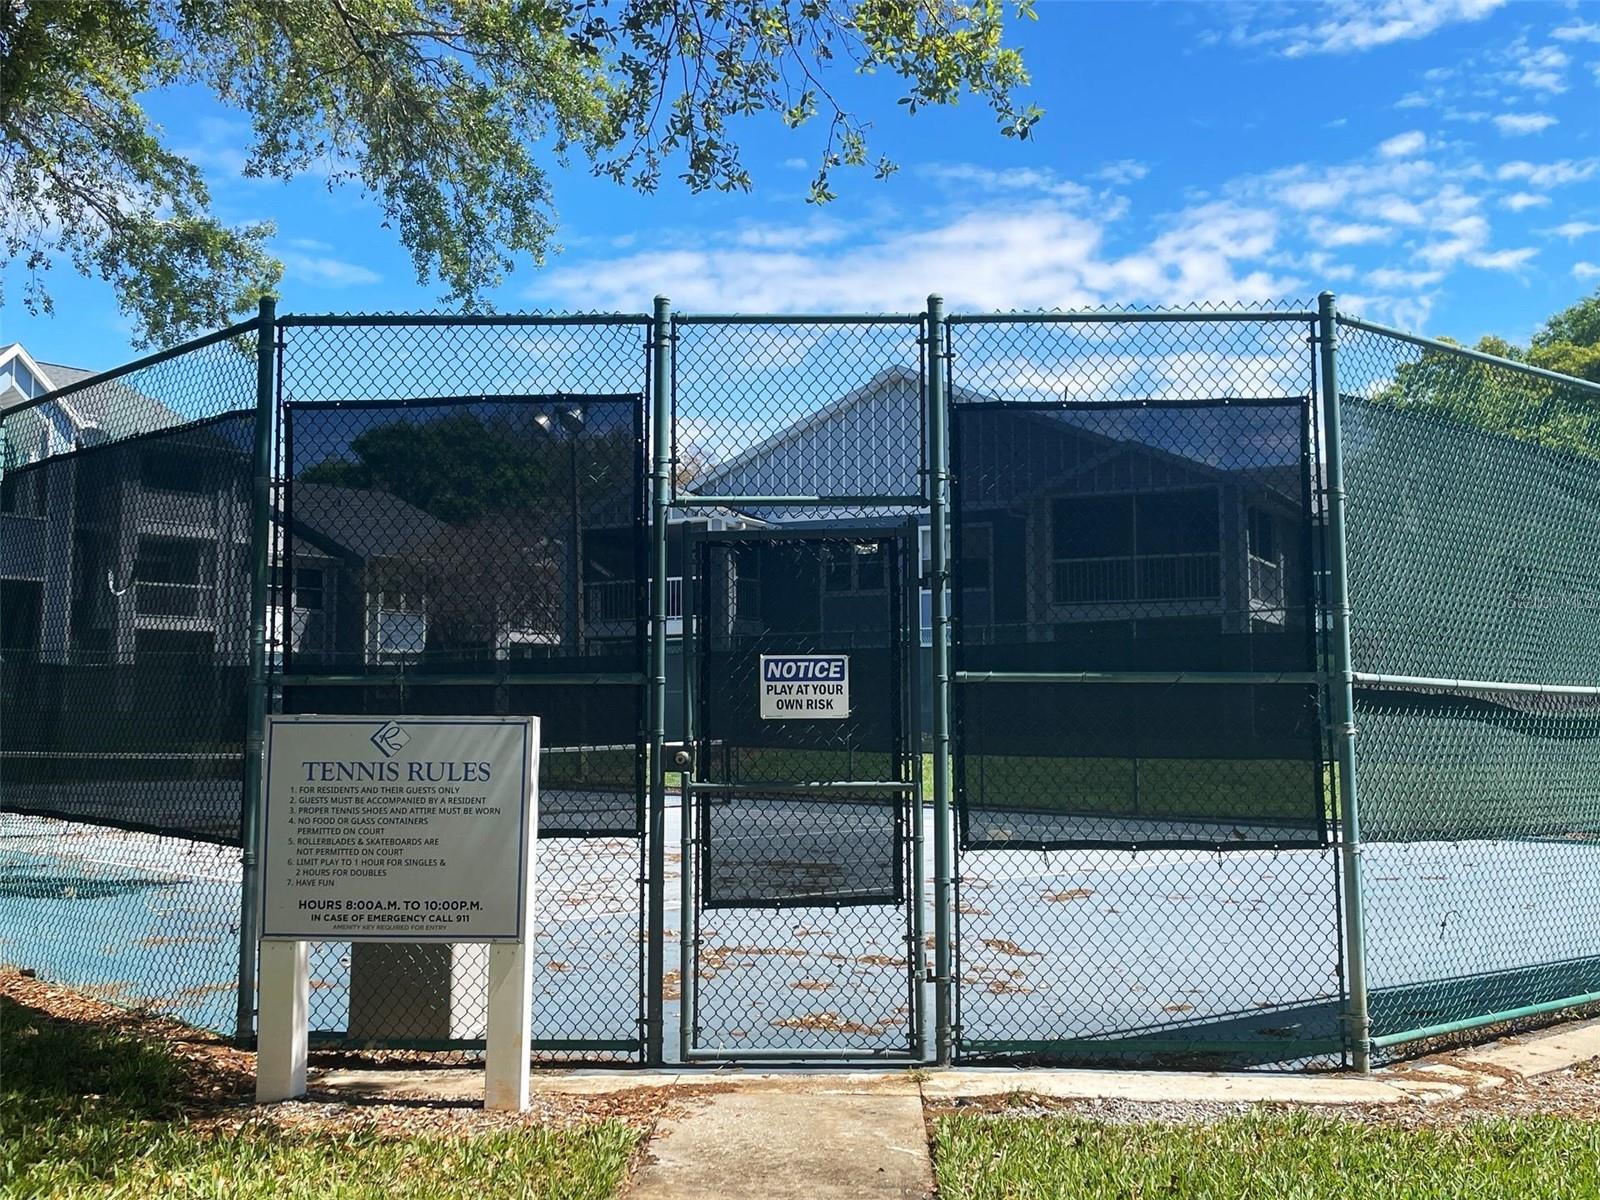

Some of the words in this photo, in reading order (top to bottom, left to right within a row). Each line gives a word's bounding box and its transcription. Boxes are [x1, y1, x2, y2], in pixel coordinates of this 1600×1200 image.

[767, 661, 843, 679] NOTICE
[766, 683, 794, 696] PLAY
[795, 683, 810, 696] AT
[811, 683, 844, 696] YOUR
[776, 698, 803, 711] OWN
[806, 698, 834, 711] RISK
[302, 762, 399, 782] TENNIS
[408, 762, 490, 782] RULES
[289, 786, 298, 795] 1.
[298, 786, 316, 795] FOR
[316, 786, 360, 795] RESIDENTS
[361, 786, 379, 795] AND
[380, 786, 405, 795] THEIR
[405, 786, 437, 795] GUESTS
[437, 786, 461, 795] ONLY
[289, 796, 297, 805] 2.
[298, 796, 329, 805] GUESTS
[330, 796, 354, 805] MUST
[354, 796, 365, 805] BE
[365, 796, 427, 805] ACCOMPANIED
[428, 796, 439, 805] BY
[439, 796, 447, 805] A
[447, 796, 487, 805] RESIDENT
[289, 806, 297, 815] 3.
[298, 806, 330, 815] PROPER
[330, 806, 361, 815] TENNIS
[361, 806, 389, 815] SHOES
[389, 806, 408, 815] AND
[408, 806, 437, 815] ATTIRE
[438, 806, 462, 815] MUST
[463, 806, 473, 815] BE
[474, 806, 501, 815] WORN
[287, 816, 297, 825] 4.
[297, 816, 311, 825] NO
[312, 816, 336, 825] FOOD
[336, 816, 350, 825] OR
[350, 816, 376, 825] GLASS
[376, 816, 429, 825] CONTAINERS
[297, 827, 342, 836] PERMITTED
[342, 827, 356, 836] ON
[357, 827, 385, 836] COURT
[287, 837, 296, 846] 5.
[297, 837, 356, 846] ROLLERBLADES
[357, 837, 364, 846] &
[365, 837, 423, 846] SKATEBOARDS
[423, 837, 440, 846] ARE
[296, 848, 314, 856] NOT
[315, 848, 360, 856] PERMITTED
[361, 848, 375, 856] ON
[375, 848, 405, 856] COURT
[287, 858, 295, 867] 6.
[296, 858, 319, 867] LIMIT
[320, 858, 340, 867] PLAY
[340, 858, 353, 867] TO
[354, 858, 359, 867] 1
[361, 858, 385, 867] HOUR
[386, 858, 403, 867] FOR
[403, 858, 438, 867] SINGLES
[439, 858, 447, 867] &
[295, 868, 301, 877] 2
[302, 868, 331, 877] HOURS
[331, 868, 349, 877] FOR
[349, 868, 388, 877] DOUBLES
[287, 878, 294, 887] 7.
[295, 878, 317, 887] HAVE
[317, 878, 335, 887] FUN
[297, 900, 342, 911] HOURS
[345, 900, 401, 911] 8:00A.M.
[402, 900, 421, 911] TO
[423, 900, 484, 911] 10:00P.M.
[310, 913, 322, 923] IN
[323, 913, 349, 923] CASE
[350, 913, 365, 923] OF
[367, 913, 427, 923] EMERGENCY
[428, 913, 454, 923] CALL
[455, 913, 470, 923] 911
